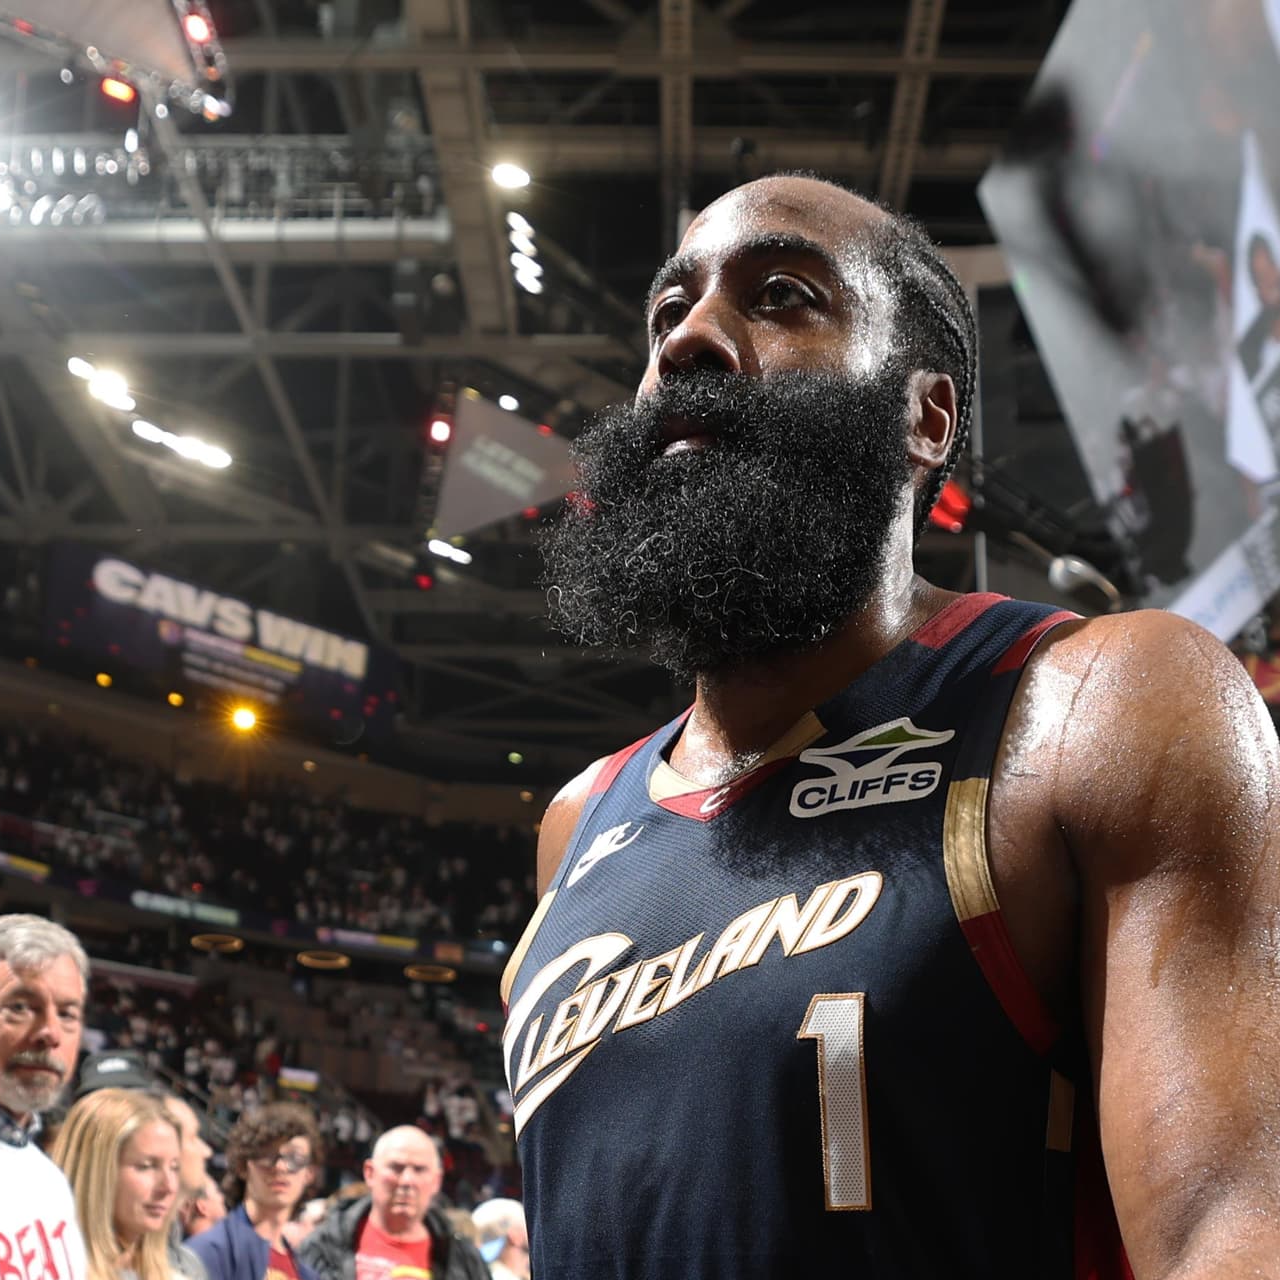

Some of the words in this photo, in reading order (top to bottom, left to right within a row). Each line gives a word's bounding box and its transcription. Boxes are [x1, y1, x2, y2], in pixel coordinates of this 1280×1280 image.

[92, 557, 254, 642] CAVS
[256, 609, 369, 681] WIN
[796, 767, 936, 811] CLIFFS
[501, 870, 884, 1144] CLEVELAND
[795, 992, 872, 1212] 1
